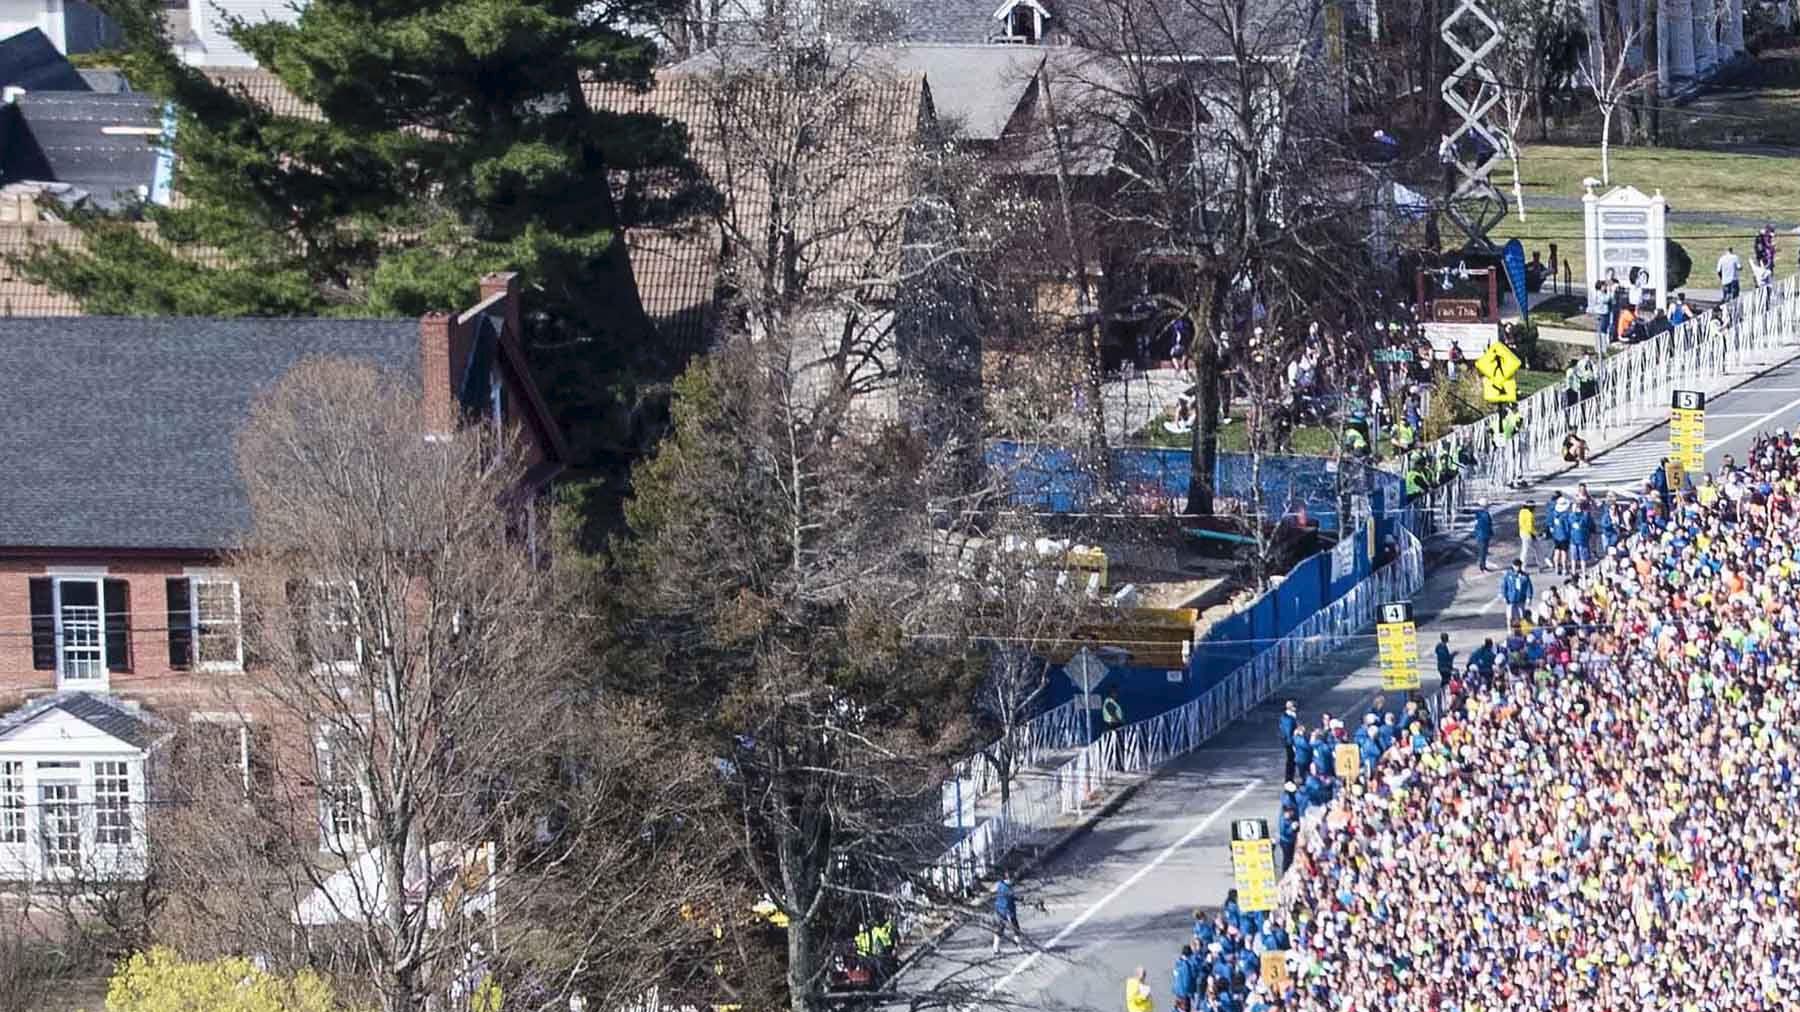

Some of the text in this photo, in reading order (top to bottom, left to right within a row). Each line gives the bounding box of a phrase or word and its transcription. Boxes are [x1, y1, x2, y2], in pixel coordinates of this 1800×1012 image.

[1683, 394, 1692, 407] 5
[1673, 472, 1681, 485] 5
[1389, 607, 1399, 620] 4
[1343, 757, 1352, 770] 4
[1270, 965, 1279, 979] 3
